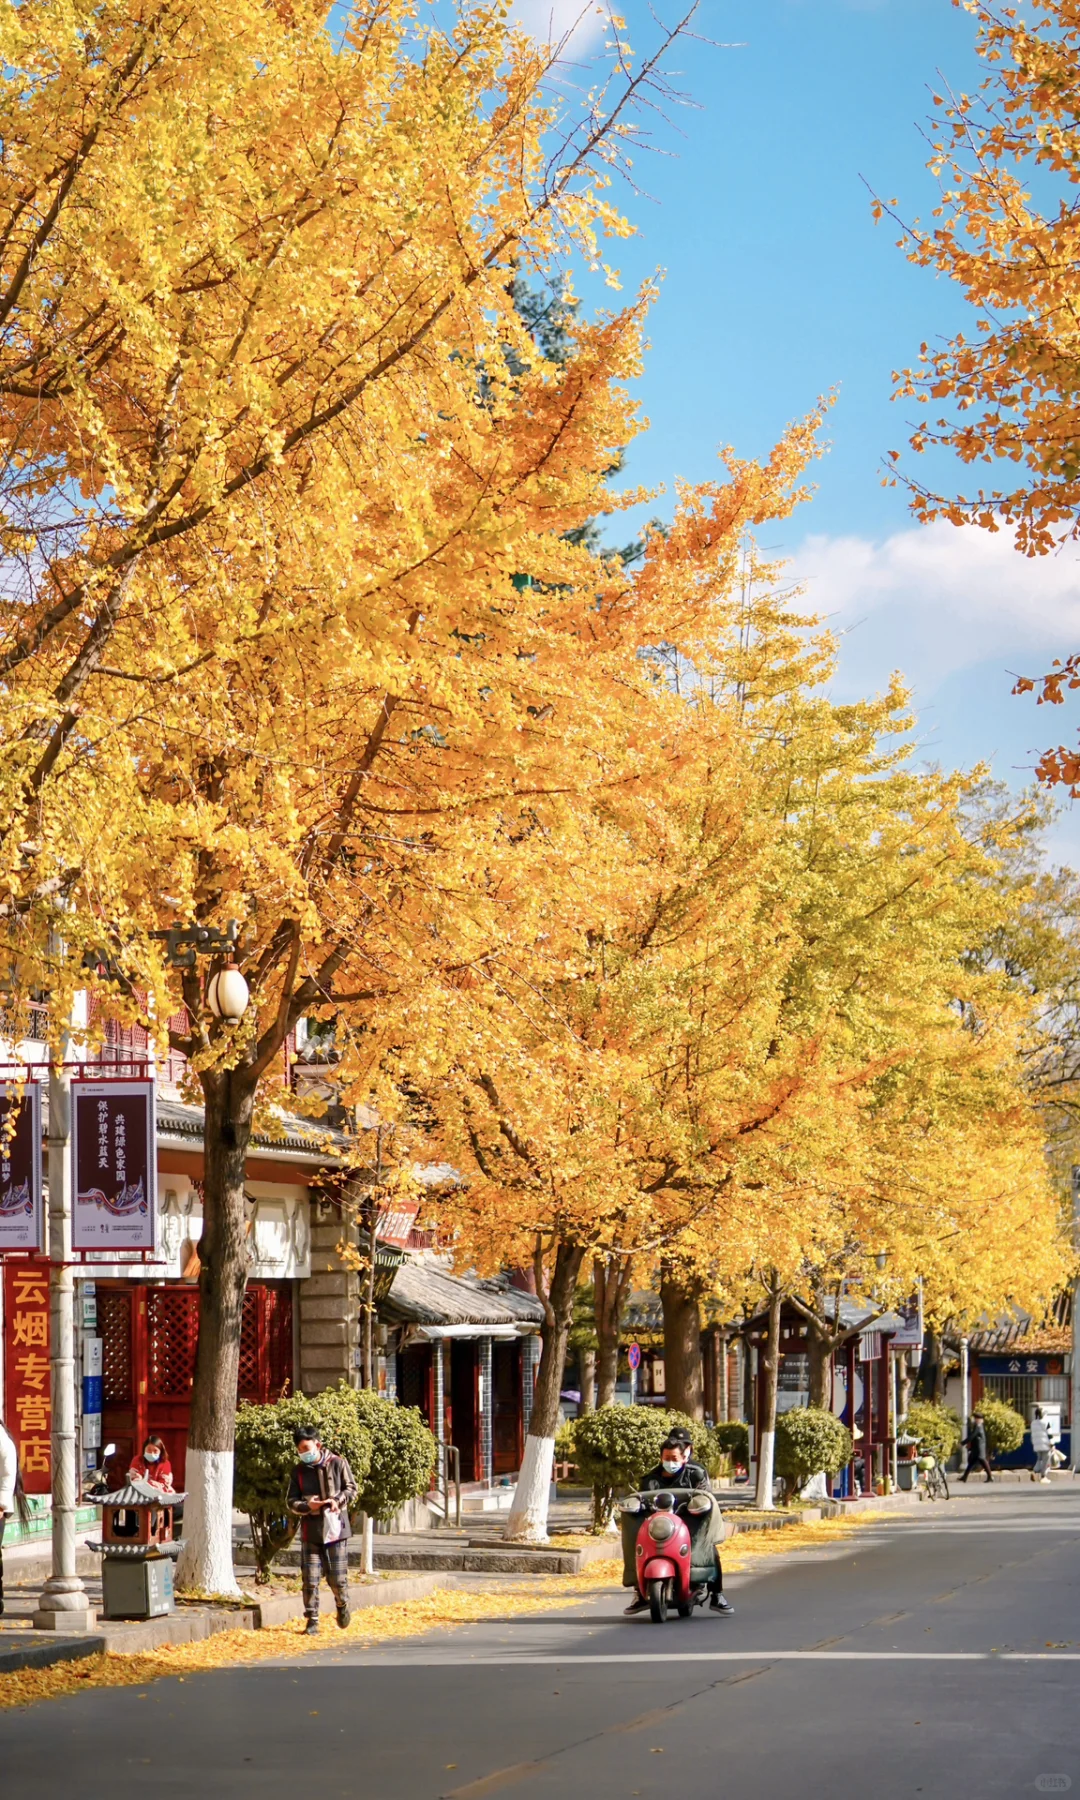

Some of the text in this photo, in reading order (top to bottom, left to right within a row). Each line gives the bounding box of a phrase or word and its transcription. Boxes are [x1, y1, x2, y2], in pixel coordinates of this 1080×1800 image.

[97, 1100, 109, 1168] 保护碧水蓝天
[114, 1114, 126, 1181] 共建绿色家园
[13, 1271, 51, 1473] 云烟专营店
[1008, 1360, 1038, 1372] 公安
